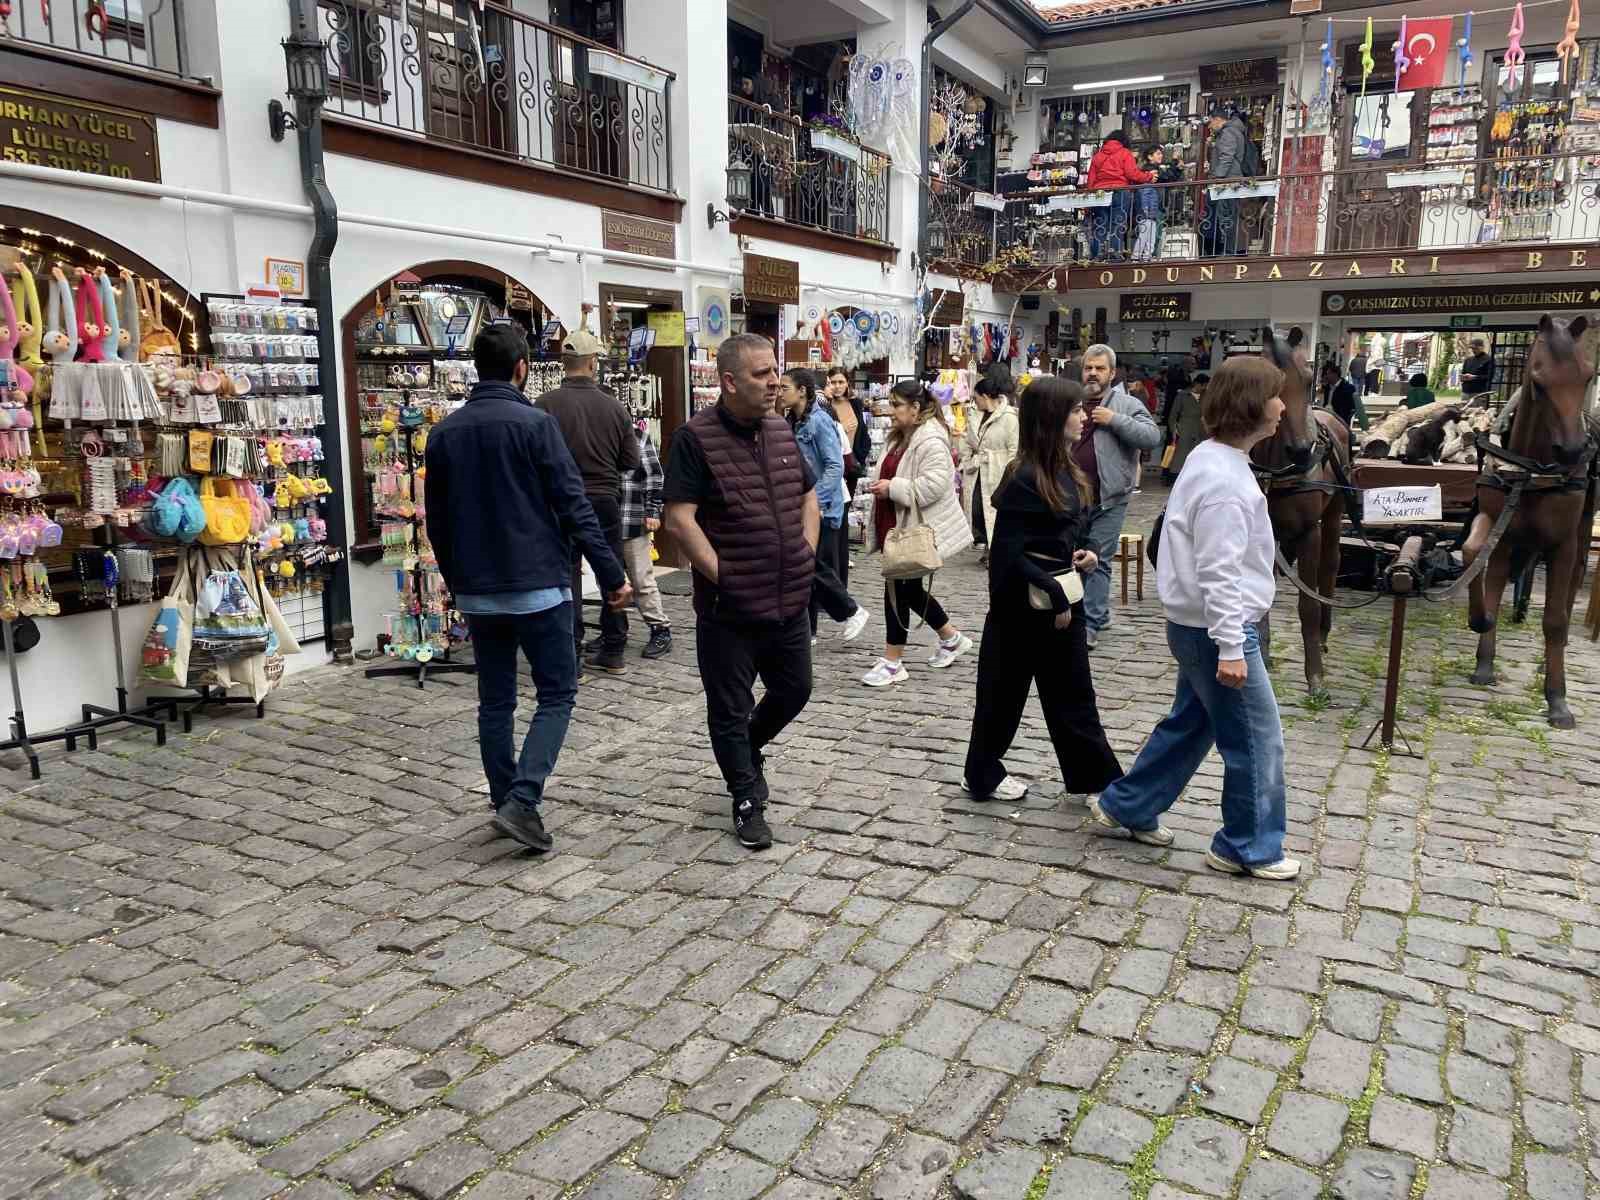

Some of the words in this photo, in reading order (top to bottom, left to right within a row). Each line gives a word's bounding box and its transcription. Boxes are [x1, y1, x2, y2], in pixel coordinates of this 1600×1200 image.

[72, 113, 136, 141] YÜCEL
[1100, 256, 1441, 286] ODUNPAZARI
[1526, 250, 1587, 269] BE
